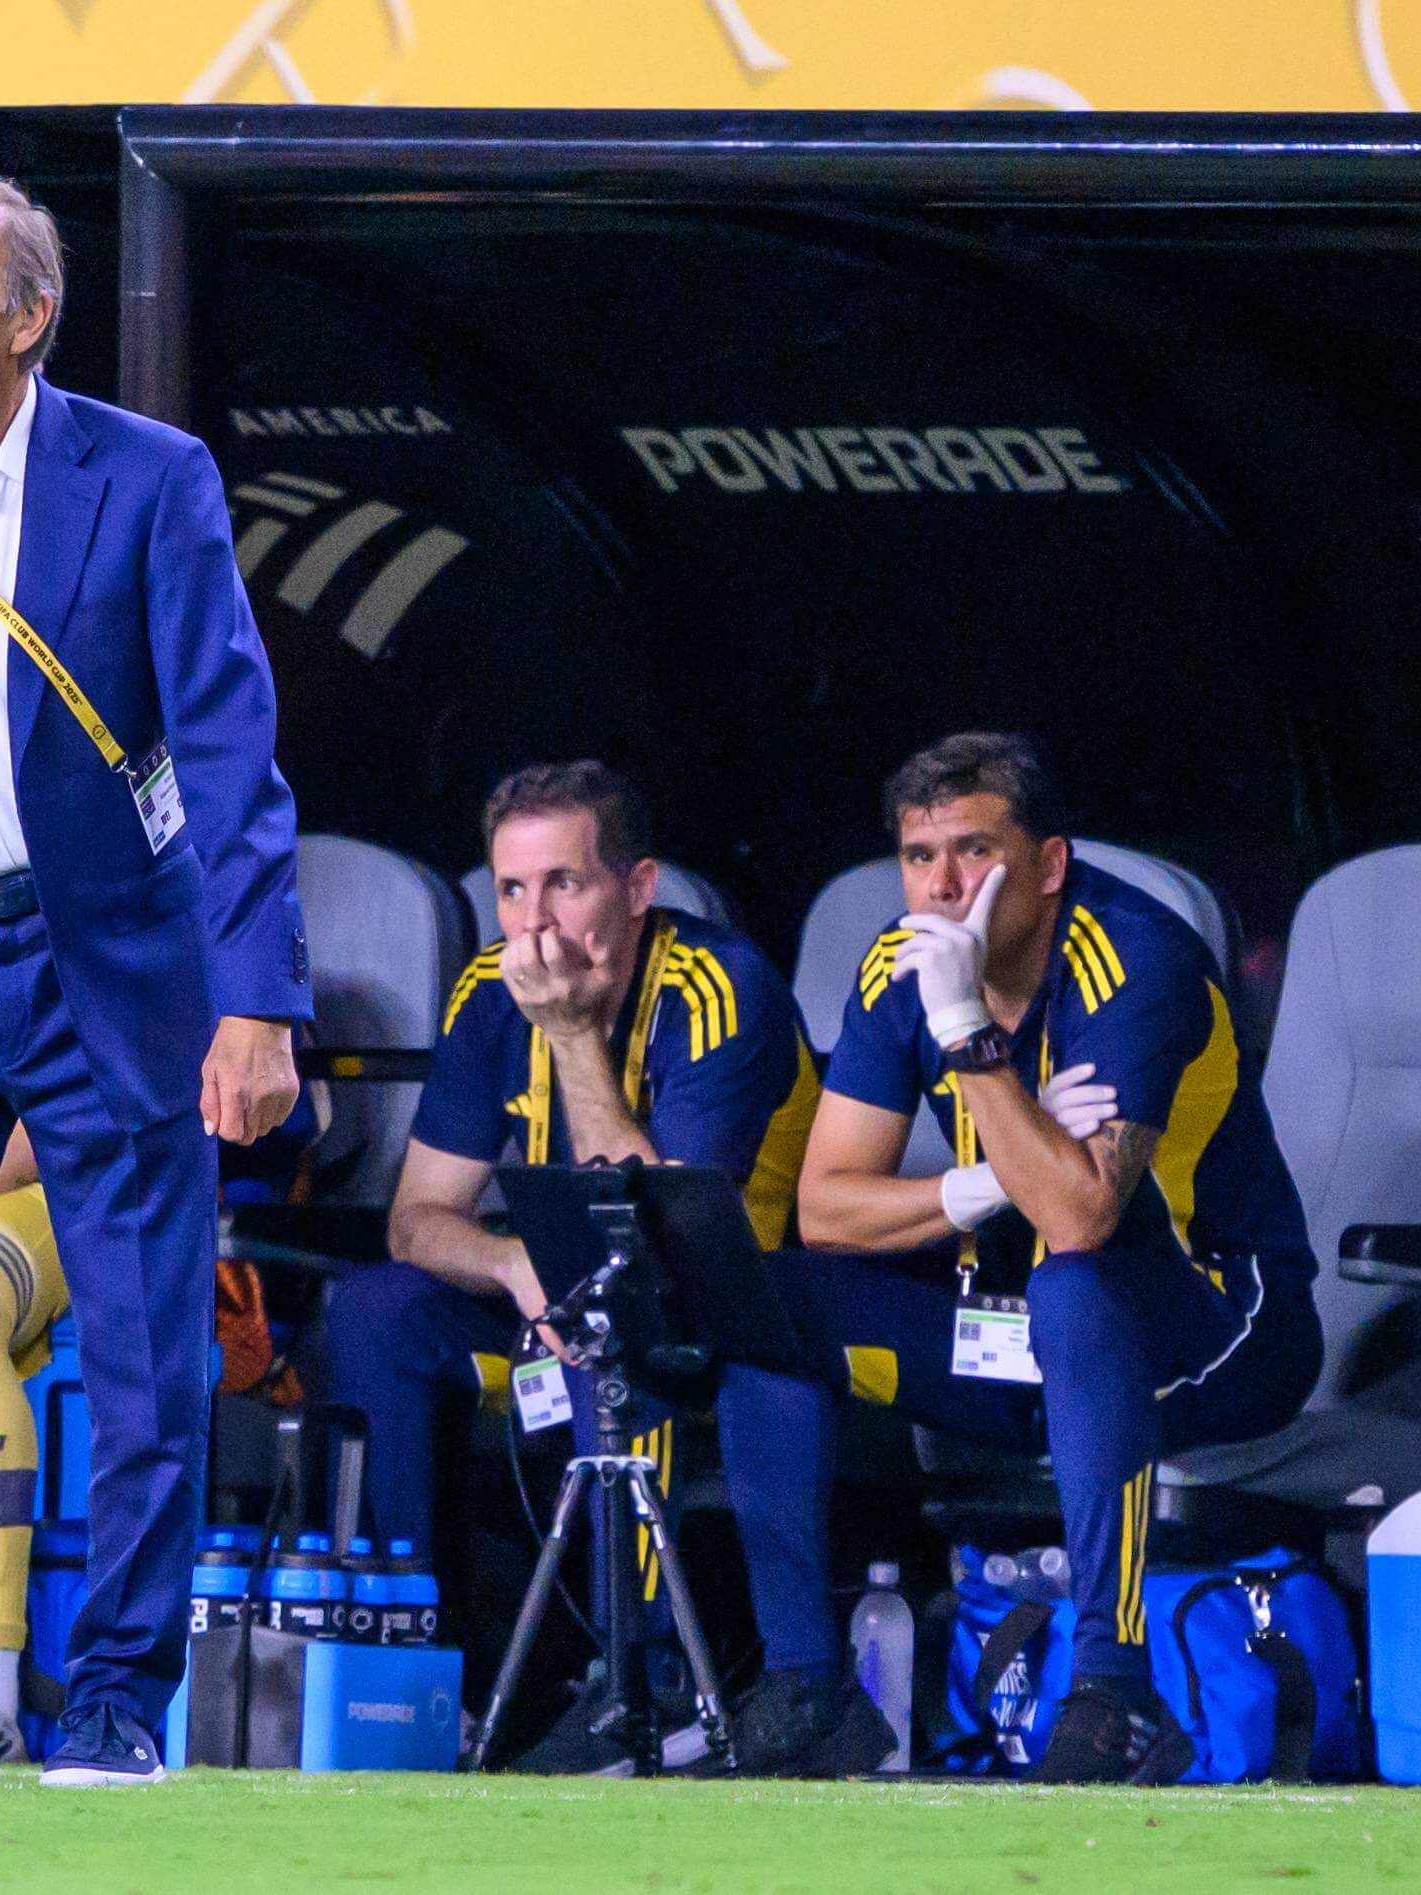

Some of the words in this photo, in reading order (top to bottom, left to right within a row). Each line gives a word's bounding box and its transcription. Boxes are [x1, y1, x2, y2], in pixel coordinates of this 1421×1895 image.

[230, 405, 452, 436] AMERICA
[620, 427, 1124, 492] POWERADE
[10, 618, 30, 639] CLUB
[27, 638, 53, 667] WORLD
[51, 666, 67, 683] CUP
